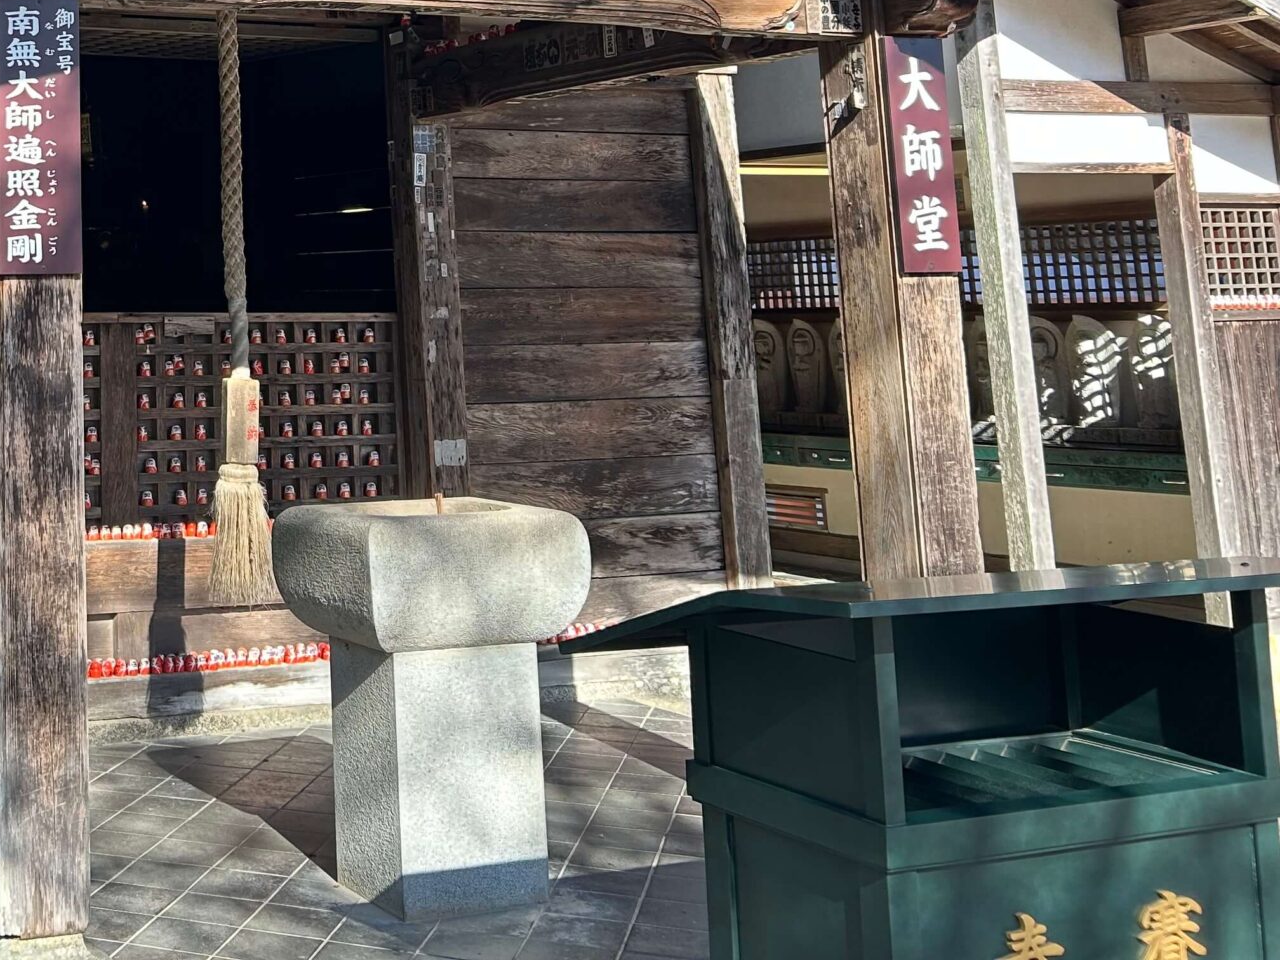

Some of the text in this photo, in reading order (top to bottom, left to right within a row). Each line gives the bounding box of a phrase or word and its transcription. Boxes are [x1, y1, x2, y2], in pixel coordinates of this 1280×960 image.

[4, 6, 46, 264] 南無大師遍照金剛
[54, 8, 75, 75] 御宝号
[898, 57, 950, 252] 大師堂
